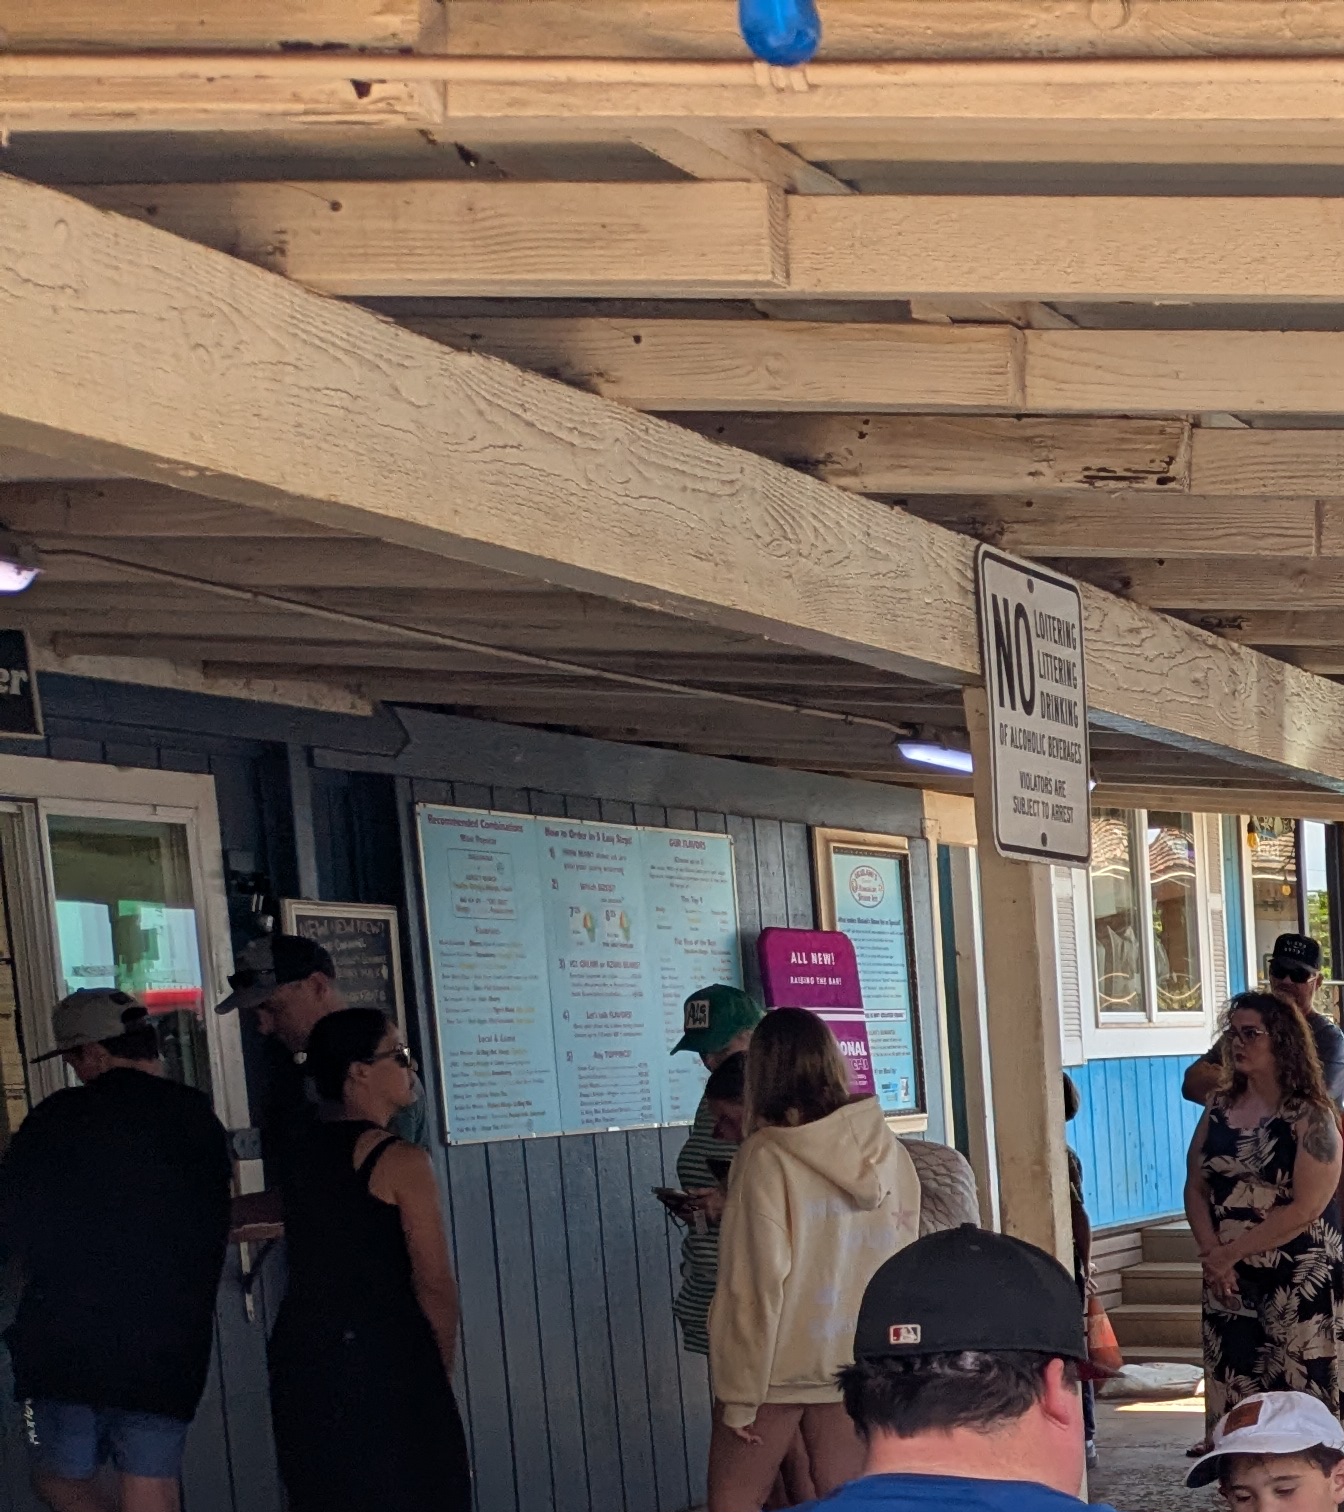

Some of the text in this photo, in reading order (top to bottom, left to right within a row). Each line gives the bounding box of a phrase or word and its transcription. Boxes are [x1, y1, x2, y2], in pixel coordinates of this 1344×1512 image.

[1034, 609, 1077, 651] LOITERING
[991, 593, 1036, 716] NO
[1037, 648, 1078, 689] LITTERING
[1040, 690, 1079, 729] DRINKING
[999, 722, 1082, 765] OF ALCOHOLIC BEVERAGES
[1019, 770, 1067, 798] VIOLATORS ARE
[1012, 795, 1074, 824] SUBJECT TO ARREST
[790, 951, 836, 966] ALL NEW!
[790, 976, 815, 985] RAISING
[816, 977, 827, 986] THE
